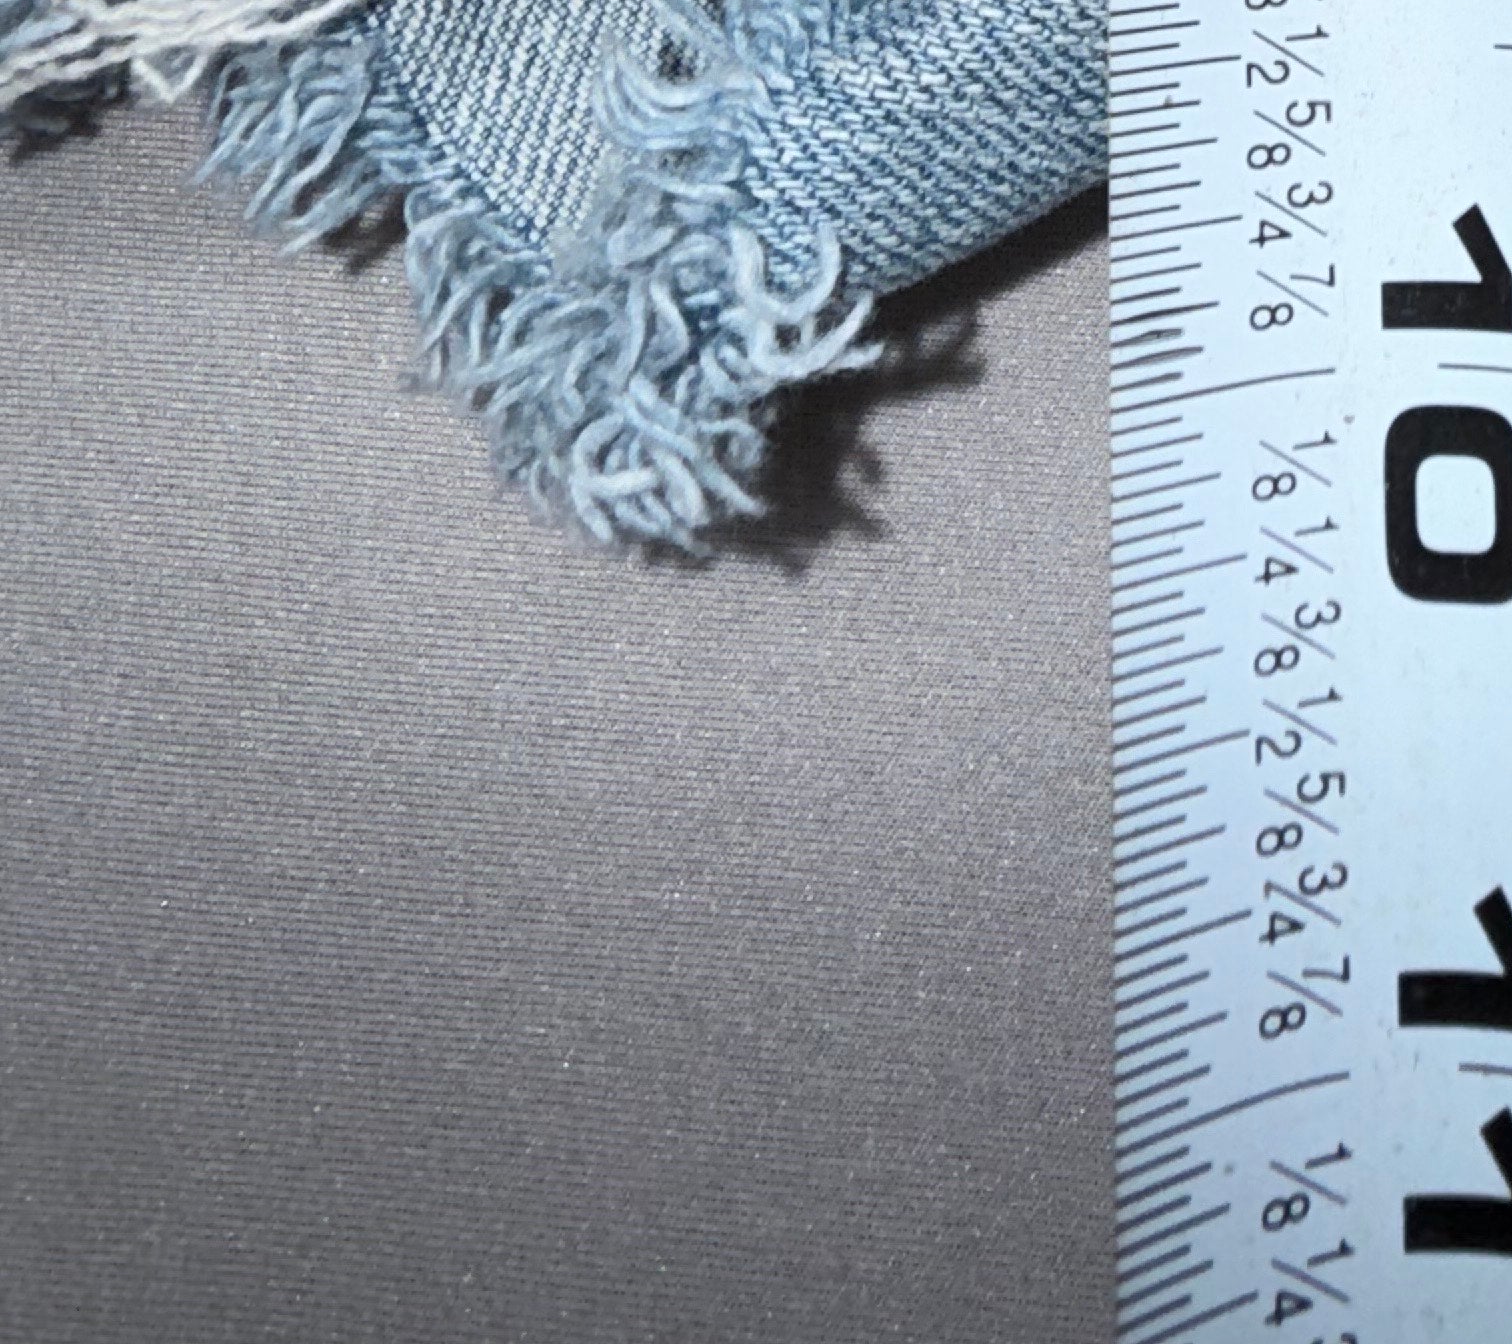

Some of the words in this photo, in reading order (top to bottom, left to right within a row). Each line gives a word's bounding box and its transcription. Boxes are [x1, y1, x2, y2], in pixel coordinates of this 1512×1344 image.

[1245, 23, 1331, 89] 1/2
[1245, 99, 1333, 172] 5/8
[1248, 180, 1335, 250] 3/4
[1248, 262, 1337, 332] 7/8
[1250, 428, 1338, 503] 1/8
[1254, 514, 1341, 587] 1/4
[1252, 598, 1343, 678] 3/8
[1254, 684, 1344, 767] 1/2
[1254, 770, 1347, 859] 5/8
[1258, 860, 1350, 947] 3/4
[1258, 953, 1352, 1041] 7/8
[1260, 1140, 1354, 1233] 1/8
[1264, 1236, 1357, 1328] 1/4
